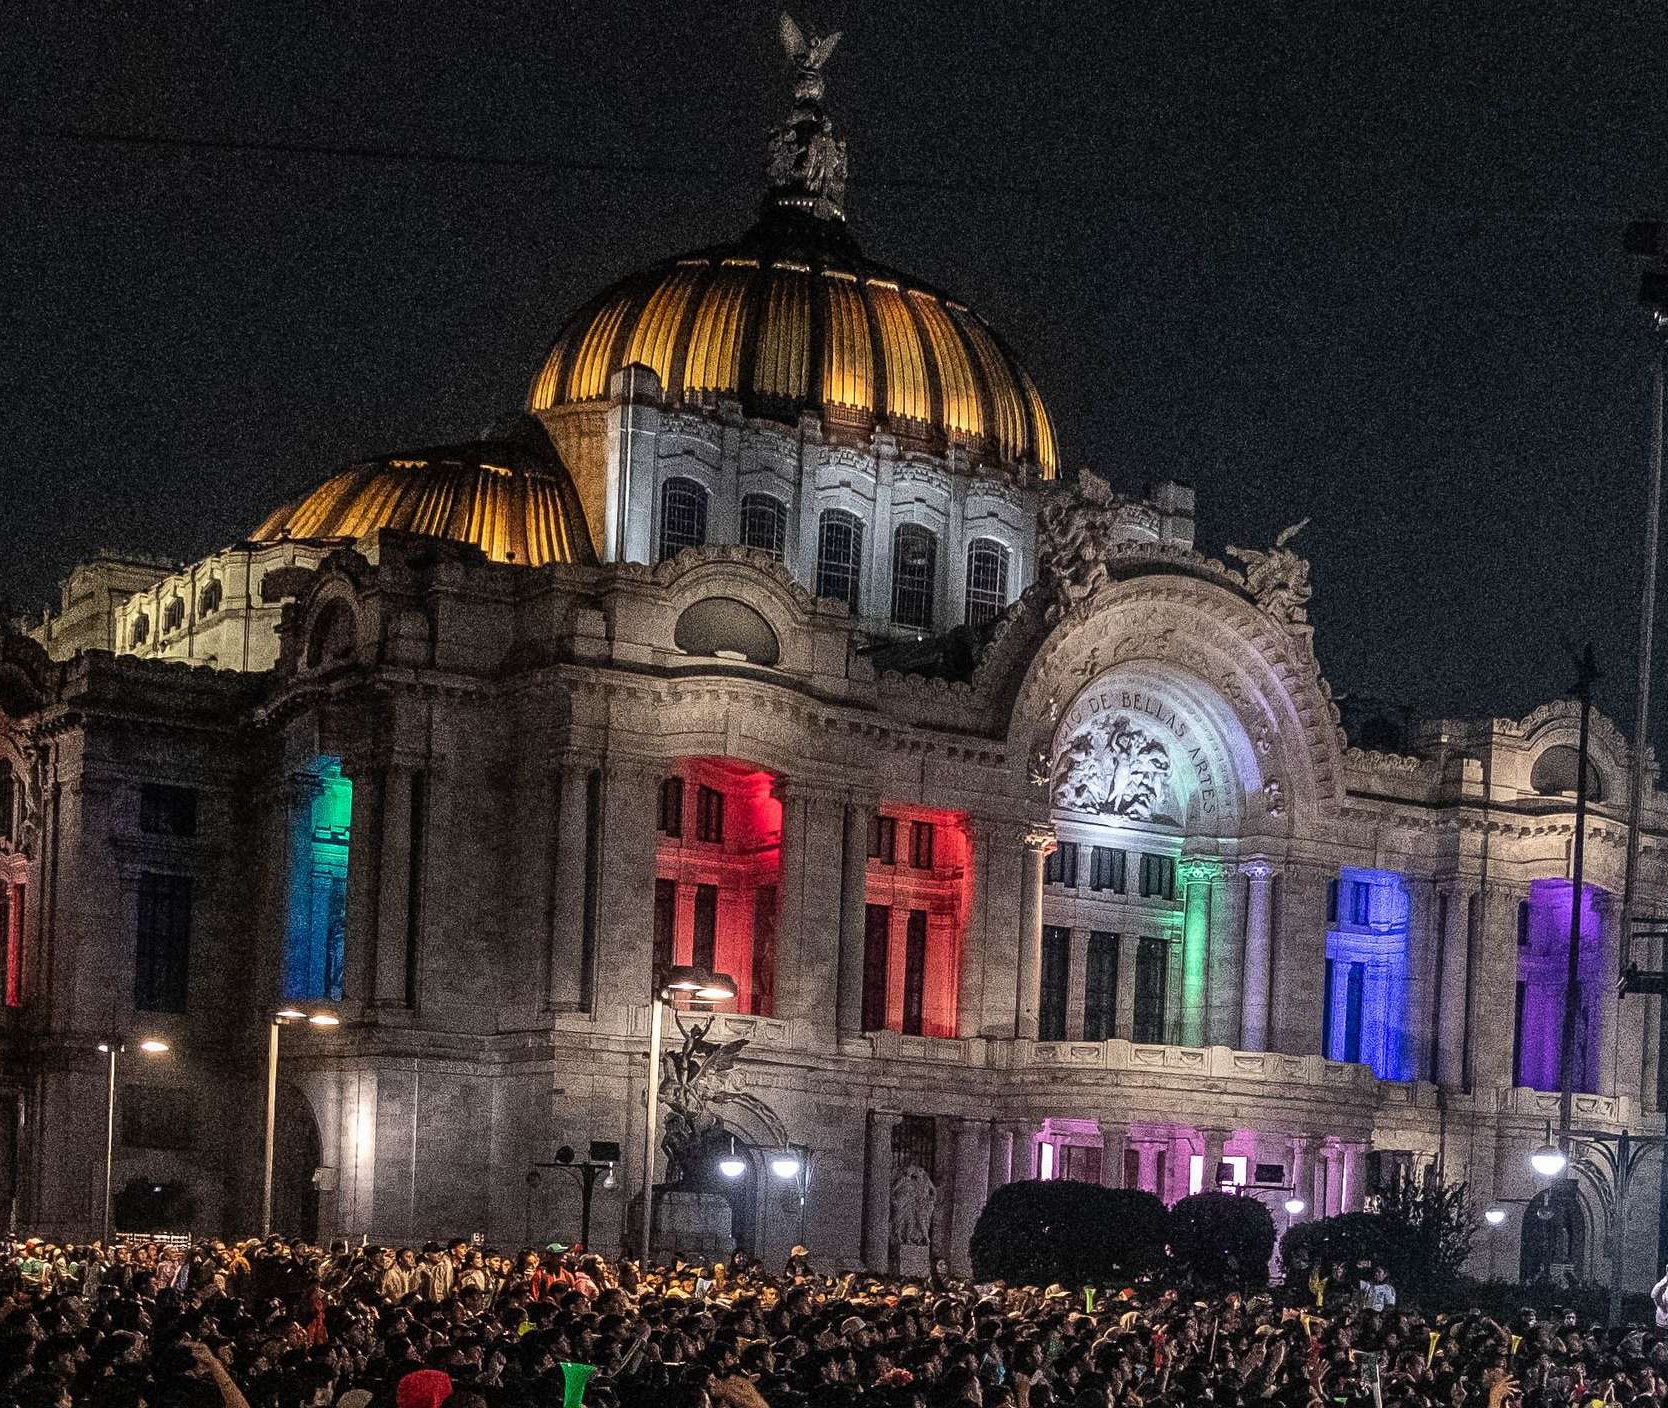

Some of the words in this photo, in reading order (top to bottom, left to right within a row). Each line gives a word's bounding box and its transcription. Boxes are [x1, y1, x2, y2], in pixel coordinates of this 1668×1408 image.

[1088, 692, 1112, 713] DE
[1122, 692, 1186, 738] BELLAS
[1188, 747, 1216, 814] ARTES
